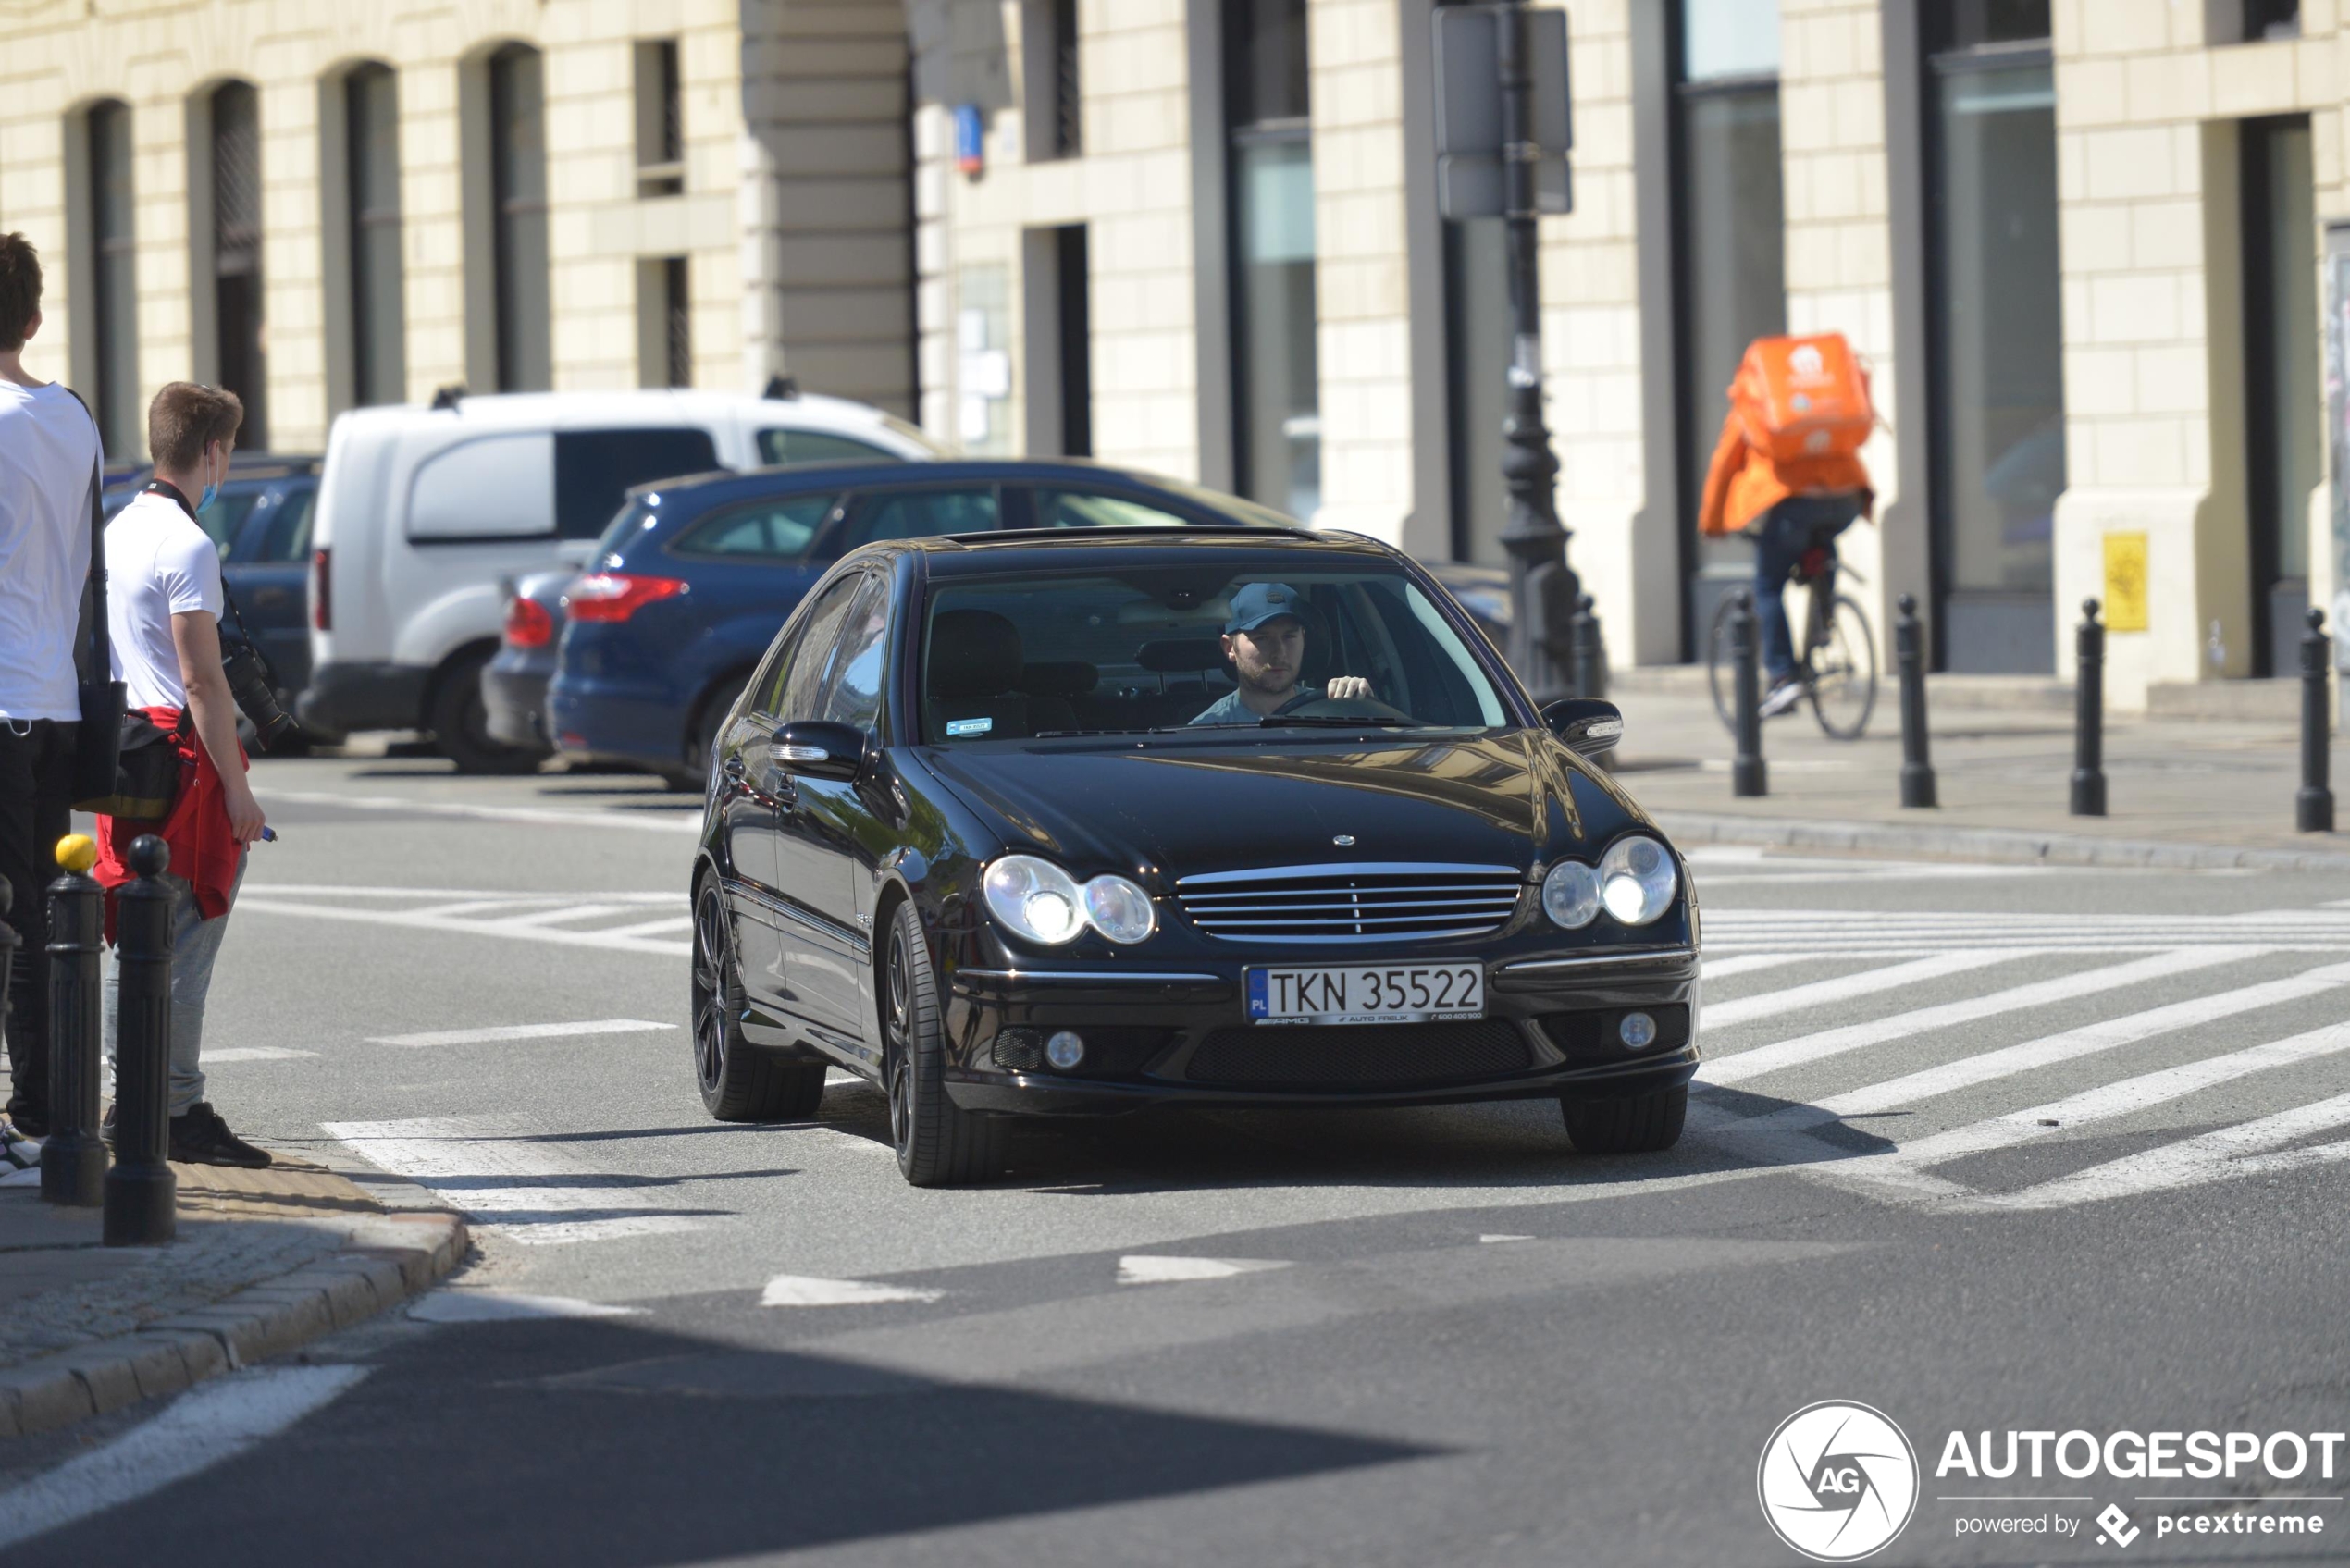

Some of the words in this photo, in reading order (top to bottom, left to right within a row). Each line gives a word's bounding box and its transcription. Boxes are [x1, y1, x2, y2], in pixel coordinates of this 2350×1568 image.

[1252, 999, 1267, 1010] PL
[1271, 972, 1346, 1013] TKN
[1361, 969, 1478, 1010] 35522
